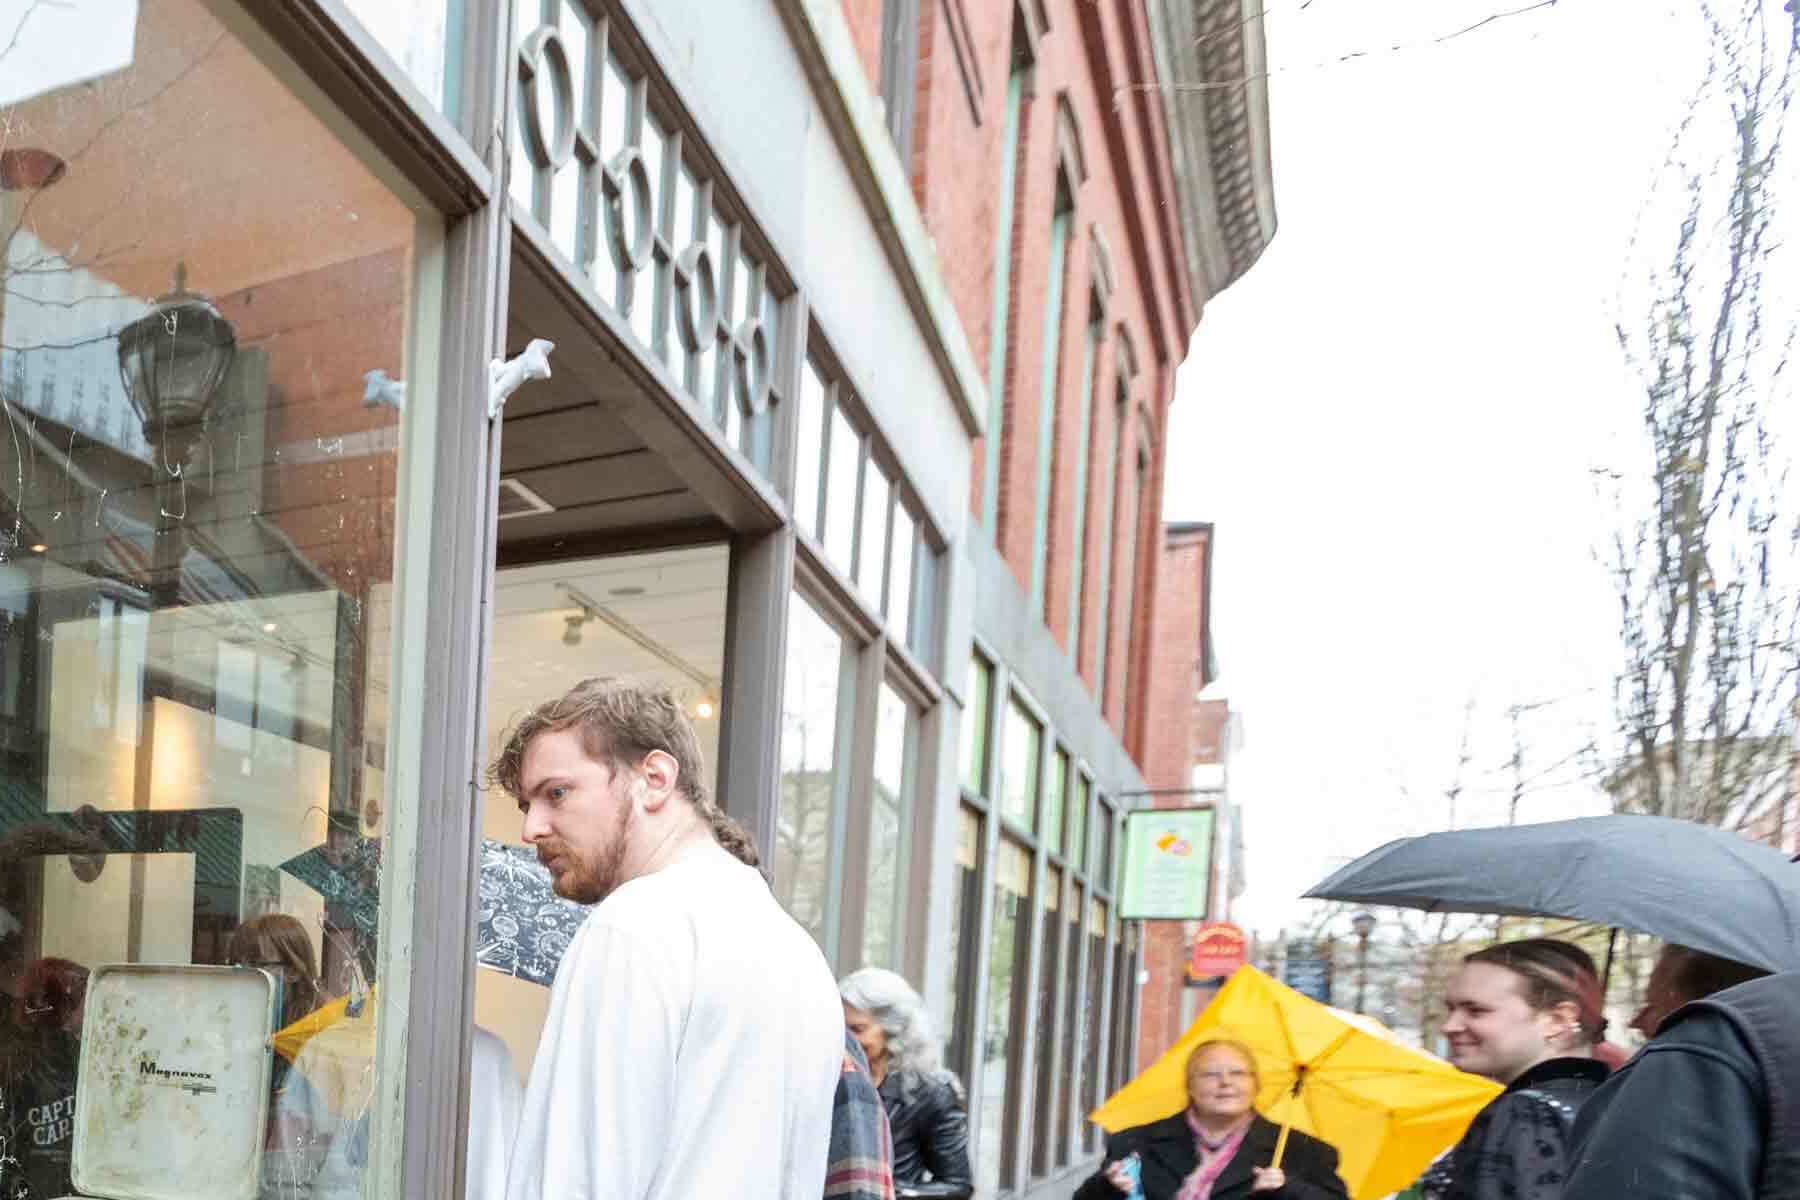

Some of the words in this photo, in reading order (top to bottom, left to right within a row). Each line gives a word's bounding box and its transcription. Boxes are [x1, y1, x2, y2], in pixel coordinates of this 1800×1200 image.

[139, 1061, 213, 1080] Magnavox
[28, 1096, 76, 1127] CAPT
[33, 1119, 73, 1146] CAR
